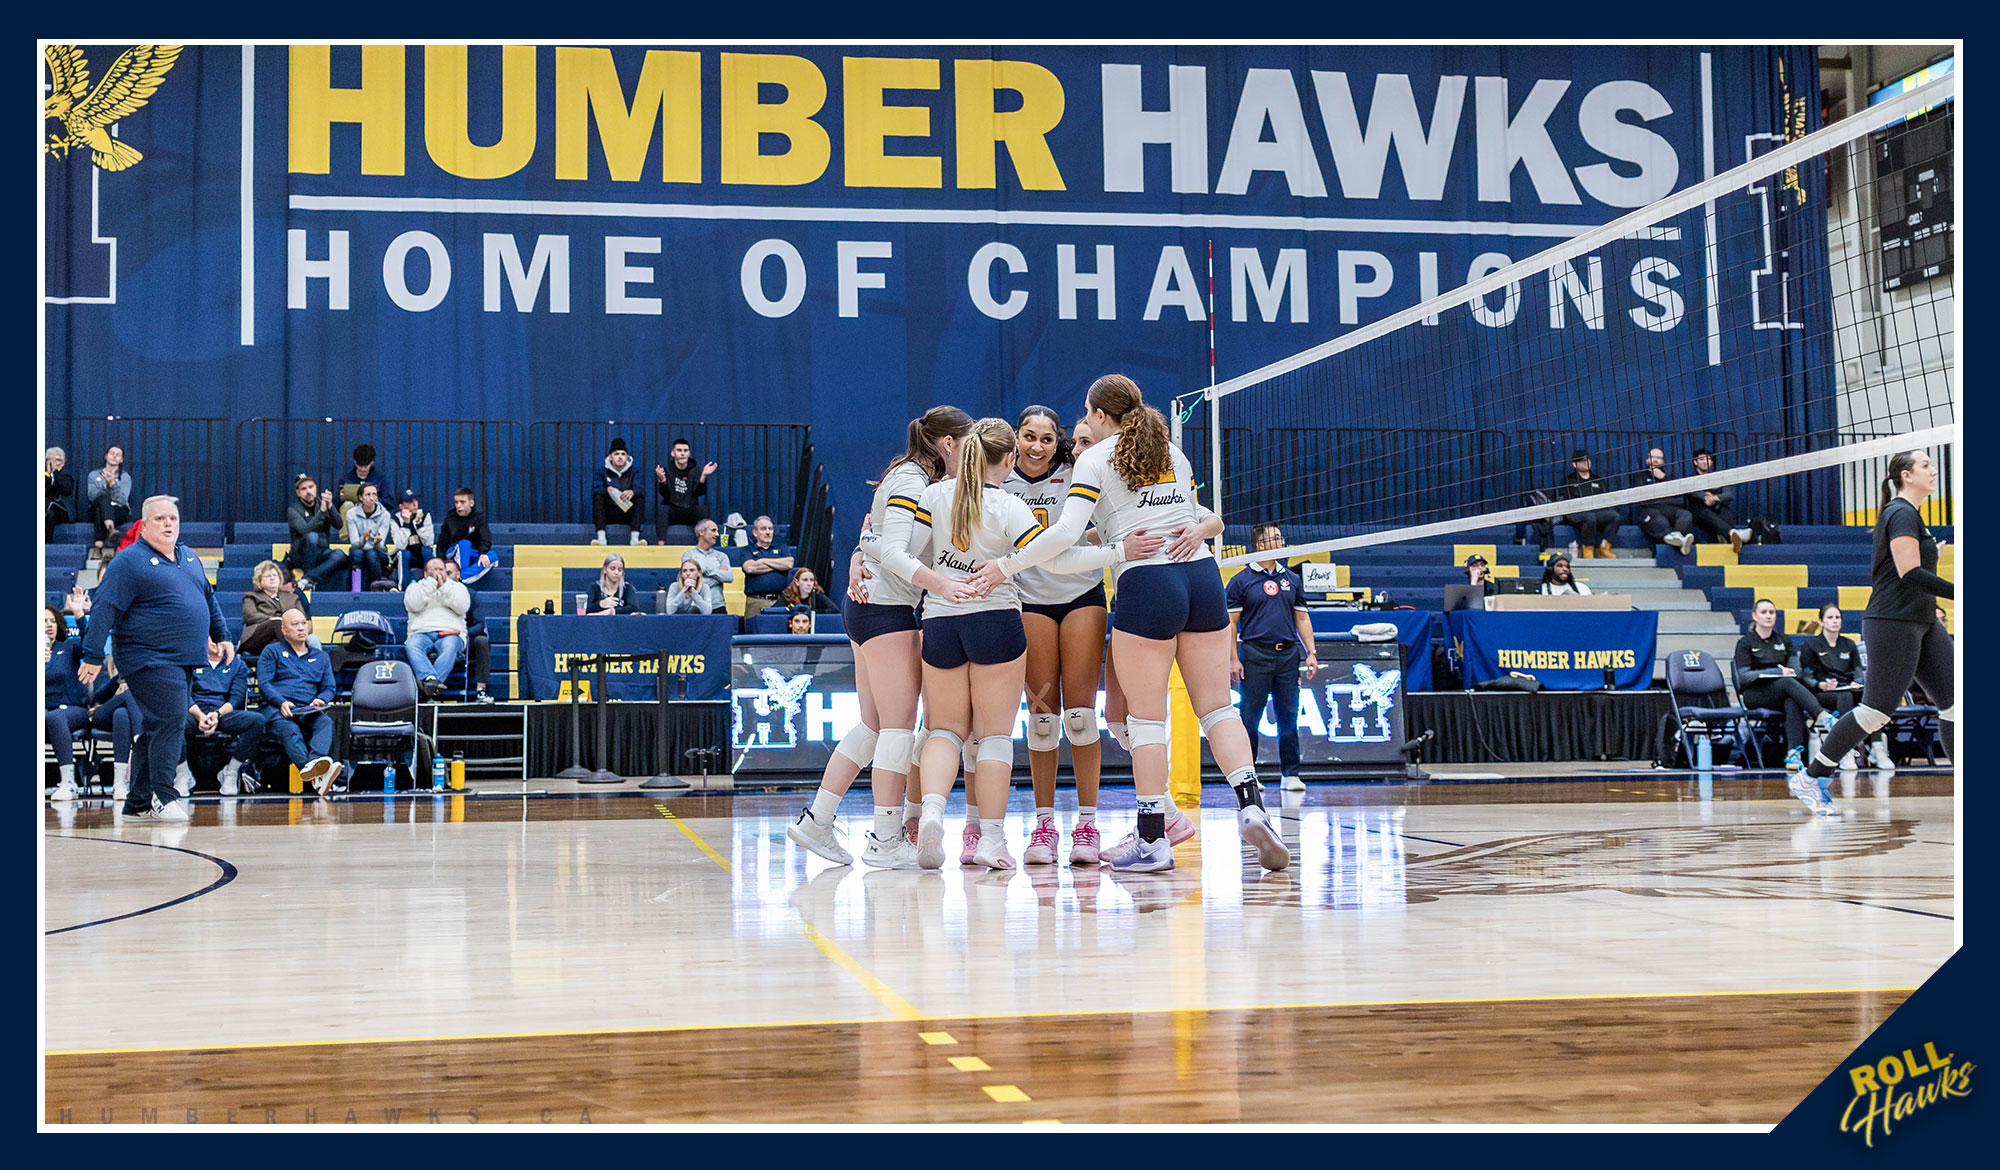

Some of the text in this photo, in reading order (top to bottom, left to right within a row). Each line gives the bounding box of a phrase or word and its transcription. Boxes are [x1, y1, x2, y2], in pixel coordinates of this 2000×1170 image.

[288, 46, 1679, 209] HUMBER HAWKS
[287, 228, 1685, 333] HOME OF CHAMPIONS
[1137, 488, 1185, 509] Hawks
[937, 549, 978, 574] Hawk
[1307, 567, 1332, 582] Lewis
[1498, 649, 1636, 670] HUMBER HAWKS
